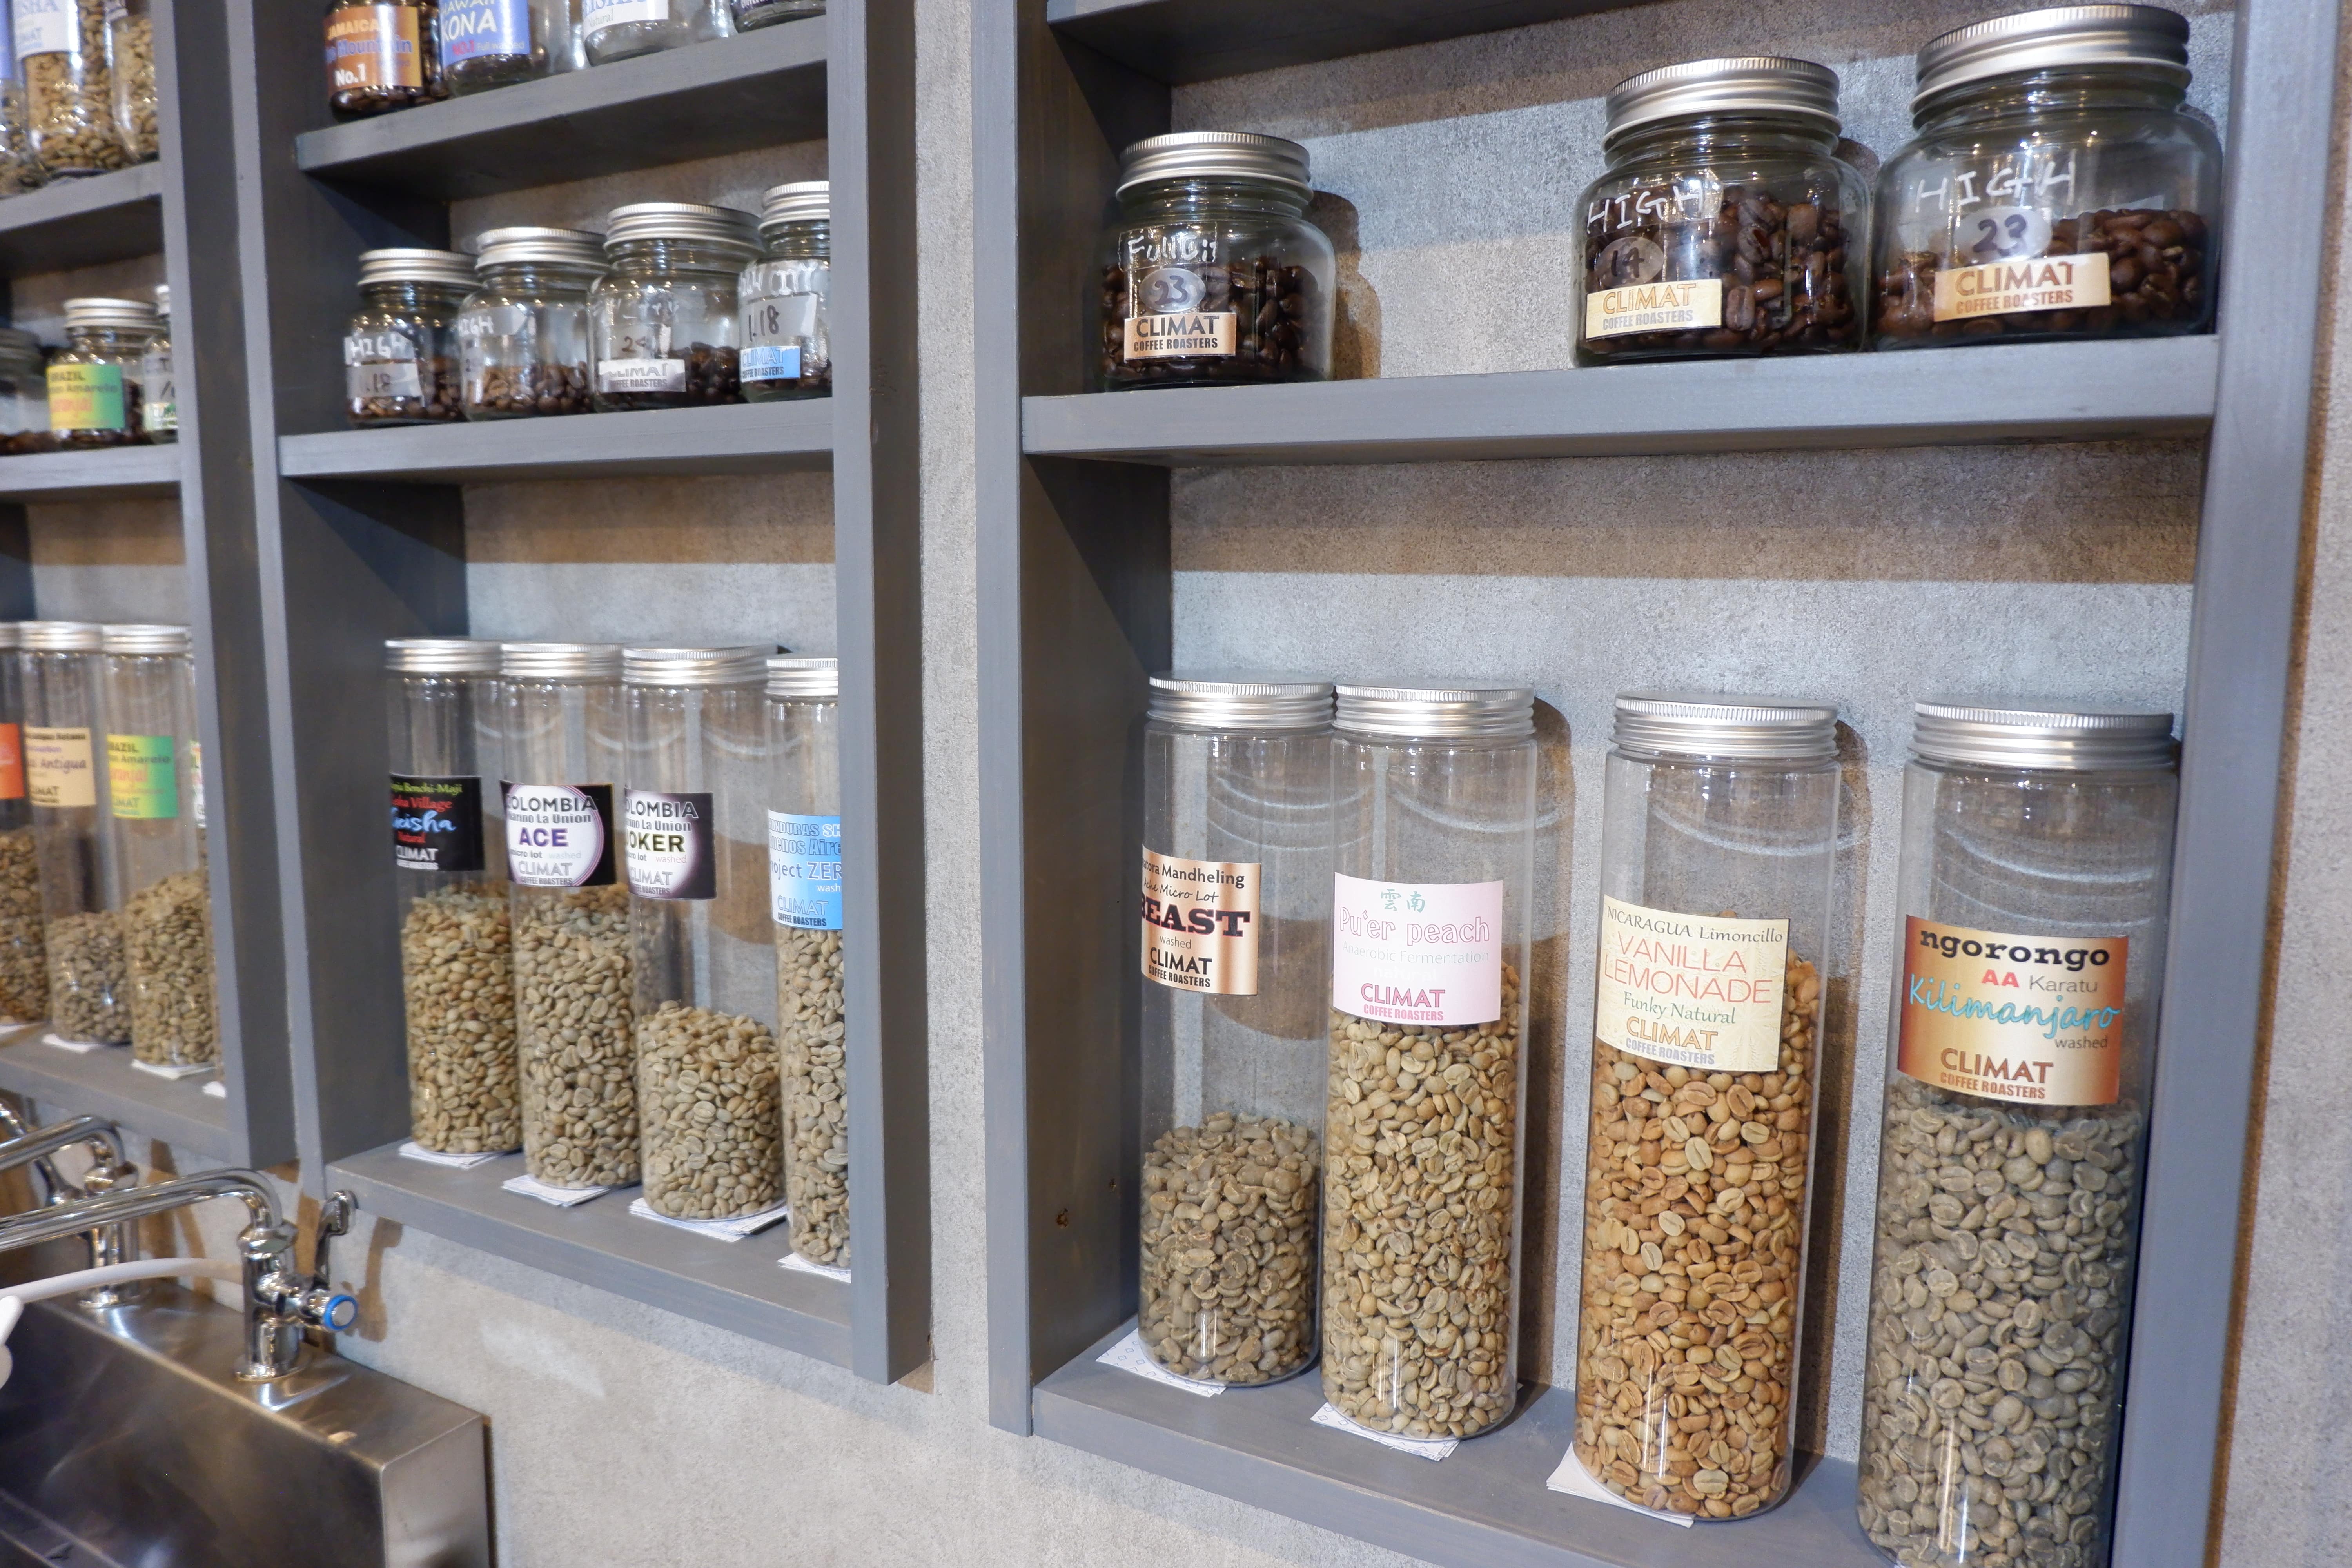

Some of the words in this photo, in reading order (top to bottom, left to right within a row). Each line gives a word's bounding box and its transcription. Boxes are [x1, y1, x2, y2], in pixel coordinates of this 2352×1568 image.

[441, 8, 497, 42] KONA
[334, 63, 366, 87] No.1
[1916, 150, 2076, 214] HIGH
[1586, 186, 1703, 234] HIGH
[1973, 213, 2028, 259] 23
[1154, 275, 1189, 306] 23
[1955, 262, 2074, 296] CLIMAT
[1602, 283, 1696, 315] CLIMAT
[1957, 296, 2000, 313] COFFEE
[2003, 289, 2073, 309] ROASTERS
[748, 305, 780, 342] 1.18
[1136, 315, 1220, 338] CLIMAT
[1602, 314, 1633, 330] COFFEE
[1635, 310, 1693, 327] ROASTERS
[351, 333, 407, 358] HIGH
[1133, 340, 1163, 352] COFFEE
[1166, 338, 1218, 350] ROASTERS
[743, 347, 784, 368] CLIMAT
[754, 362, 784, 377] ROASTERS
[630, 379, 667, 388] ROASTERS
[537, 813, 549, 824] La
[552, 813, 592, 824] Union
[626, 797, 699, 818] OLOMBIA
[519, 827, 569, 847] ACE
[642, 819, 652, 830] La
[654, 821, 692, 832] Union
[822, 824, 841, 837] SH
[550, 851, 582, 860] washed
[637, 851, 647, 862] lot
[655, 855, 687, 863] washed
[809, 838, 842, 856] Aire
[519, 860, 573, 877] CLIMAT
[629, 866, 673, 886] CLIMAT
[771, 858, 803, 880] roject
[807, 861, 842, 880] ZER
[1142, 858, 1160, 875] atora
[1162, 863, 1245, 889] Mandheling
[817, 883, 841, 892] wash
[1160, 884, 1193, 899] Micro
[1195, 891, 1219, 903] Lot
[777, 895, 829, 916] CLIMAT
[1380, 888, 1425, 913] 雲南
[778, 912, 792, 924] COFFEE
[793, 916, 827, 926] ROASTERS
[1407, 916, 1490, 946] peach
[1607, 906, 1693, 938] NICARAGUA
[1700, 926, 1783, 943] Limoncillo
[1159, 935, 1192, 949] washed
[1343, 941, 1396, 962] Anaerobic
[1400, 950, 1489, 964] Fermentation
[1618, 931, 1747, 973] VANILLA
[1920, 929, 2110, 972] ngorongo
[1150, 947, 1212, 975] CLIMAT
[1149, 965, 1167, 980] COFFEE
[1168, 972, 1211, 988] ROASTERS
[1604, 953, 1773, 1004] LEMONADE
[1981, 968, 2020, 988] AA
[2029, 975, 2098, 993] Karatu
[1361, 983, 1446, 1008] CLIMAT
[1624, 991, 1667, 1020] Funky
[1671, 1002, 1737, 1024] Natural
[1909, 973, 2121, 1040] Kilimanjaro
[1364, 1004, 1392, 1018] COFFEE
[1394, 1009, 1444, 1021] ROASTERS
[1626, 1016, 1719, 1051] CLIMAT
[2054, 1035, 2108, 1049] washed
[1626, 1037, 1657, 1056] COFFEE
[1659, 1046, 1715, 1065] ROASTERS
[1940, 1047, 2054, 1083] CLIMAT
[1940, 1071, 1978, 1091] COFFEE
[1981, 1080, 2046, 1099] ROASTERS
